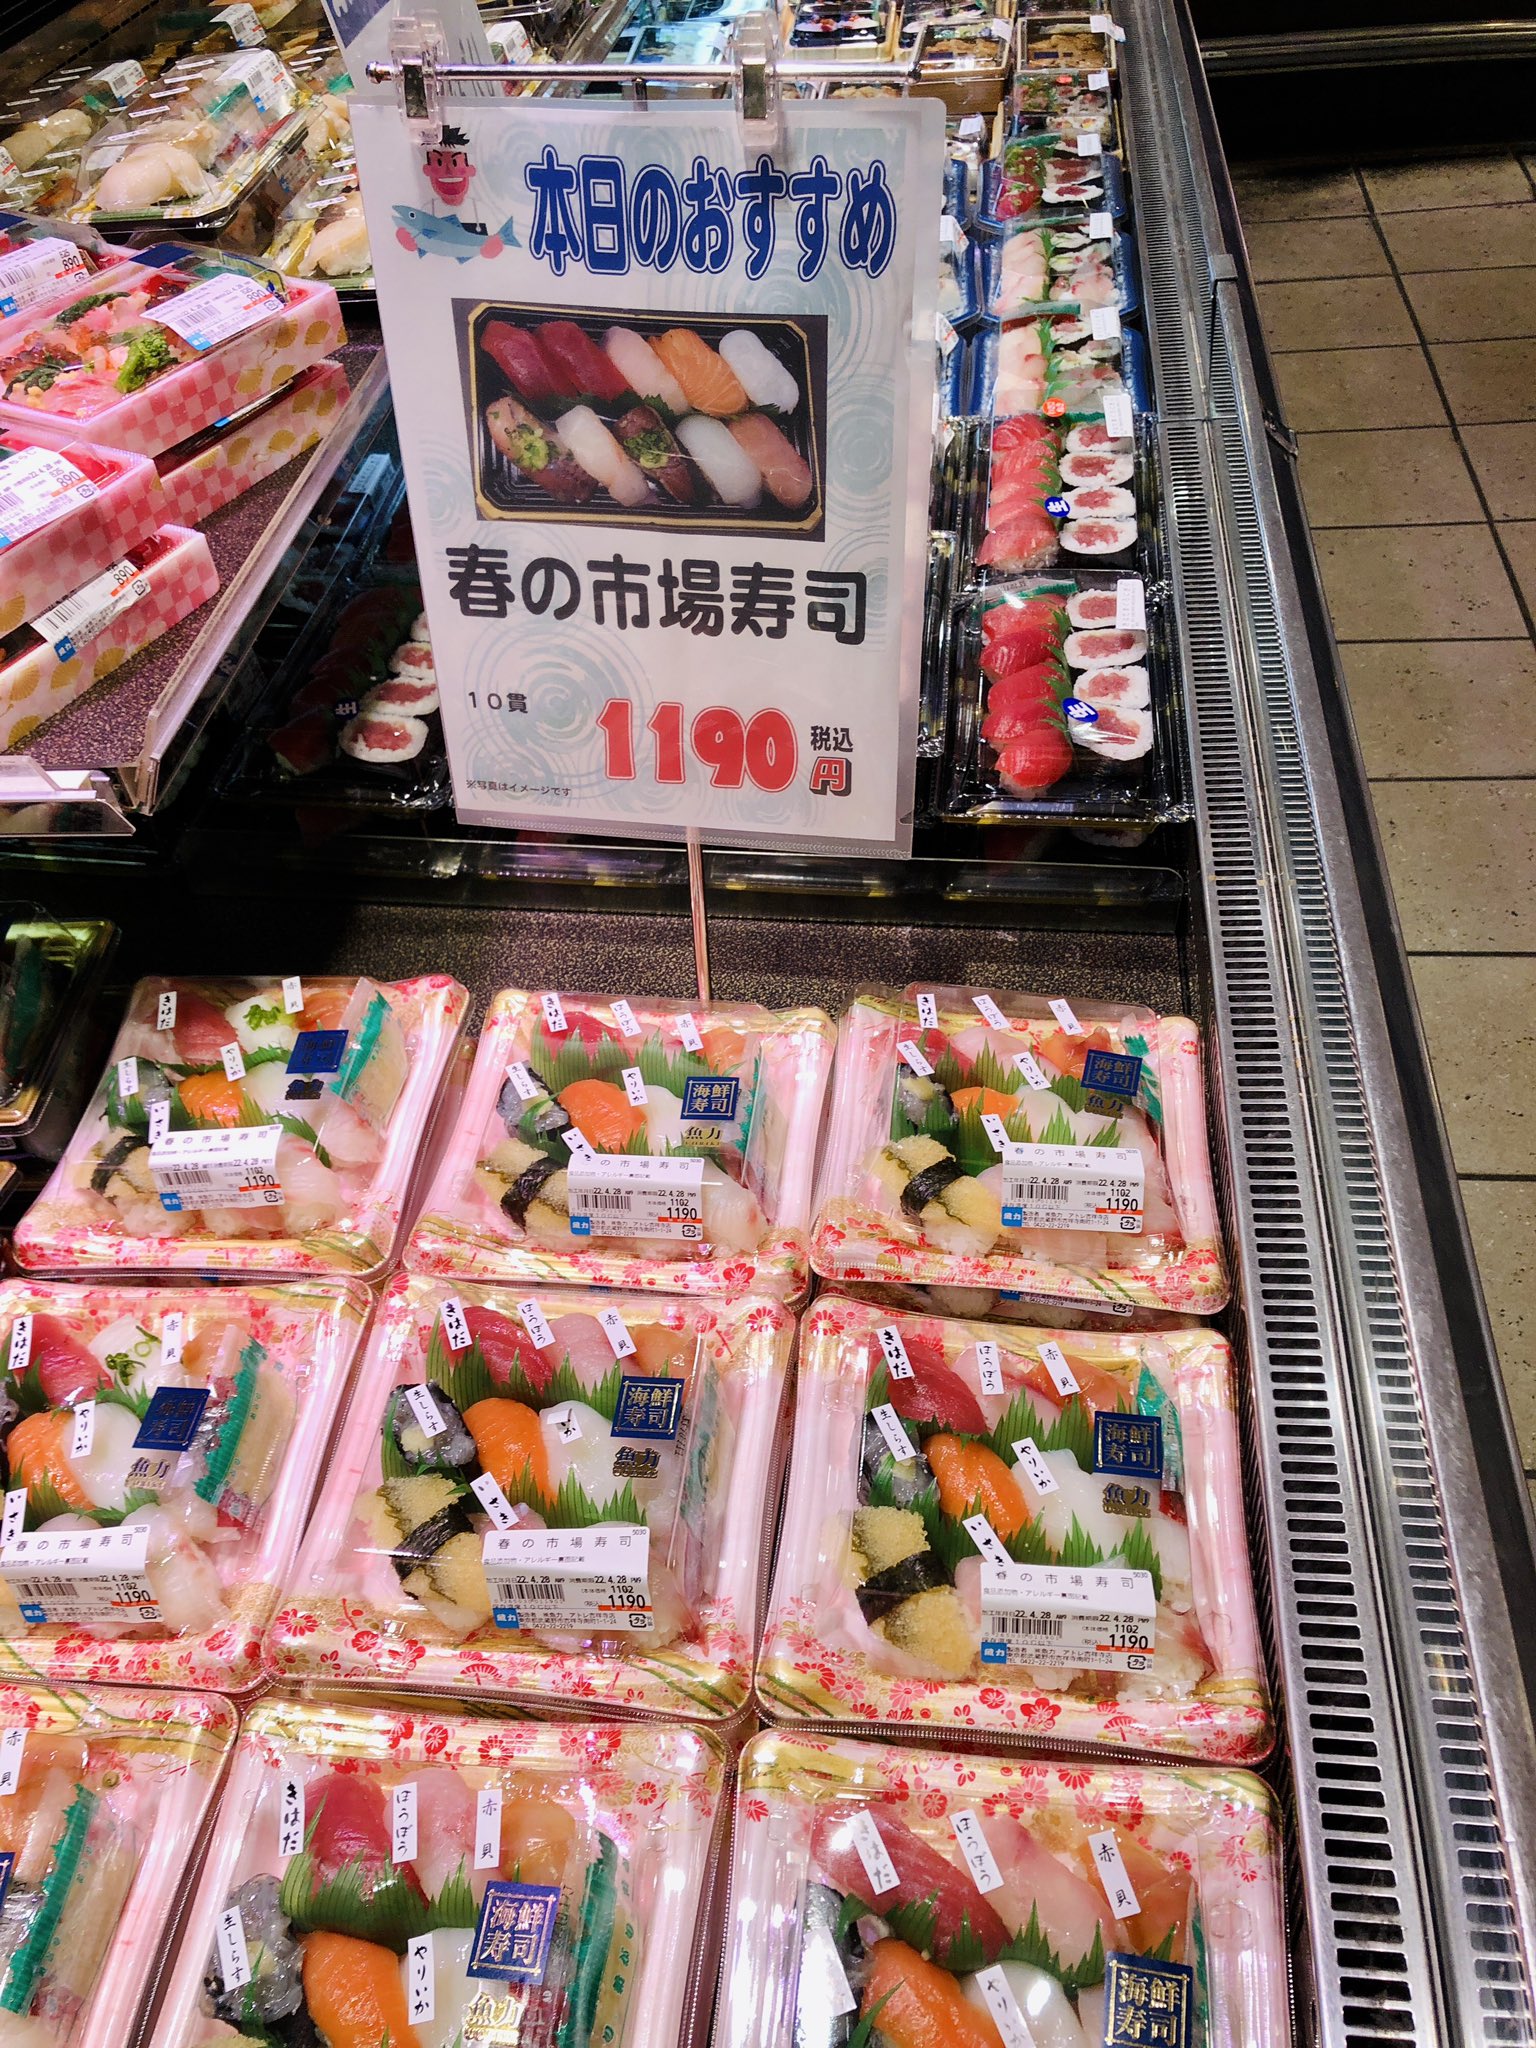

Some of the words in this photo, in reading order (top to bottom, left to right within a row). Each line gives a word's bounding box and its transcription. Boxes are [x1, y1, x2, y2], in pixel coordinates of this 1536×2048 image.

[524, 144, 896, 281] 本日のおすすめ
[62, 255, 80, 271] 890
[56, 470, 80, 487] 890
[113, 565, 134, 586] 890
[445, 543, 867, 645] 春の市場寿司
[467, 692, 529, 714] 10貫
[596, 698, 799, 793] 1190
[810, 725, 854, 752] 税込
[809, 756, 853, 797] 円
[160, 996, 174, 1028] きはだ
[546, 996, 563, 1031] きはだ
[922, 996, 934, 1027] きはだ
[681, 1019, 698, 1046] 赤貝
[1015, 1147, 1127, 1160] 春の市場寿司
[244, 1174, 275, 1188] 1190
[1110, 1188, 1131, 1197] 1102
[666, 1207, 698, 1221] 1190
[670, 1198, 689, 1207] 1102
[1106, 1198, 1139, 1212] 1190
[165, 1319, 180, 1359] 赤貝
[446, 1301, 467, 1347] きはだ
[604, 1313, 630, 1351] 赤貝
[11, 1320, 30, 1367] きはだ
[883, 1329, 909, 1375] きはだ
[979, 1345, 996, 1392] ほうぼう
[1045, 1348, 1071, 1388] 赤貝
[412, 1389, 439, 1432] 生しらす
[627, 1387, 673, 1407] 海鮮
[76, 1407, 90, 1454] やりいか
[622, 1406, 669, 1428] 寿司
[880, 1408, 908, 1456] 生しらす
[1105, 1423, 1152, 1446] 海鮮
[1020, 1444, 1053, 1490] やりいか
[1104, 1443, 1151, 1466] 寿司
[16, 1533, 133, 1552] 春の市場寿司
[498, 1535, 631, 1550] 春の市場寿司
[610, 1585, 635, 1594] 1102
[996, 1570, 1135, 1590] 春の市場寿司
[1133, 1571, 1149, 1579] 5030
[115, 1590, 151, 1603] 1190
[608, 1594, 646, 1608] 1190
[1109, 1634, 1149, 1650] 1190
[1114, 1624, 1139, 1634] 1102
[282, 1781, 301, 1855] きはだ
[395, 1790, 413, 1858] ほうぼう
[480, 1798, 498, 1859] 赤貝
[956, 1816, 992, 1887] ほうぼう
[1098, 1842, 1131, 1907] 赤貝
[490, 1900, 545, 1932] 海鮮
[224, 1914, 244, 1982] 生しらす
[484, 1930, 539, 1965] 寿司
[413, 1945, 429, 2015] やりいか
[1118, 1970, 1181, 2013] 海鮮
[1115, 2005, 1177, 2046] 寿司
